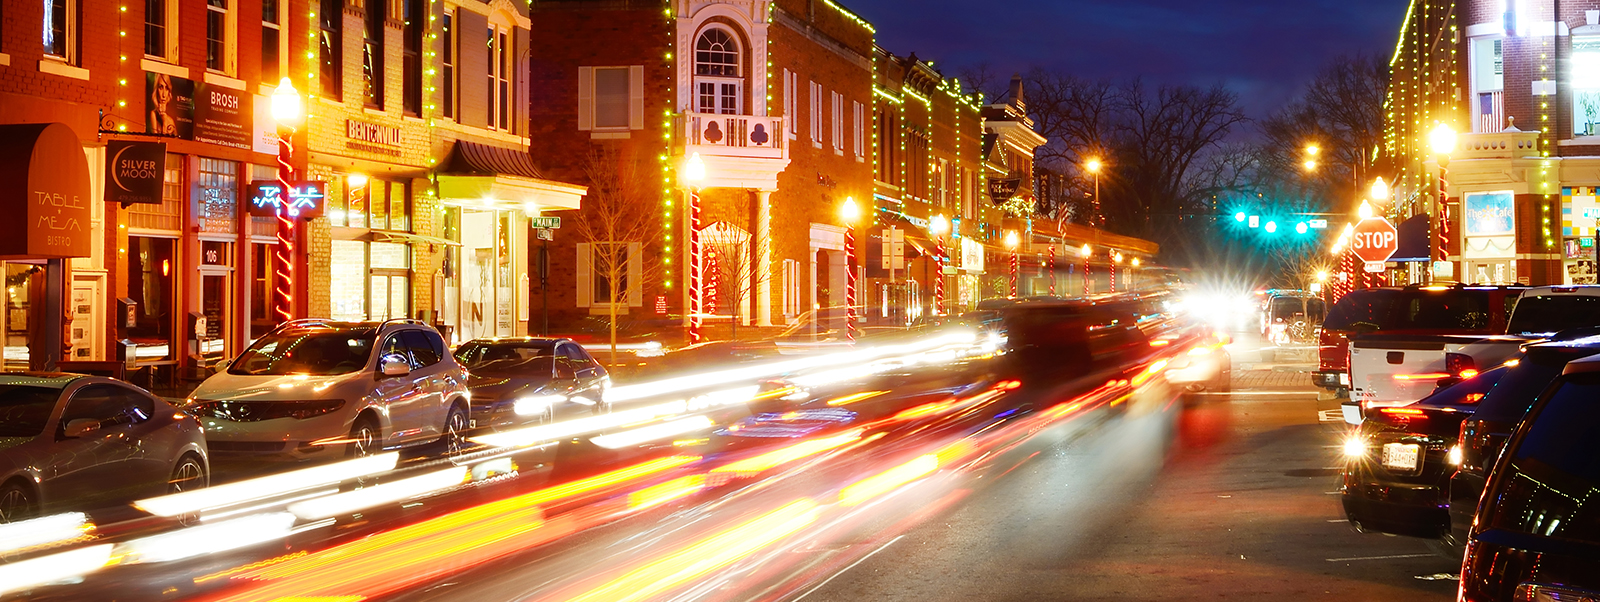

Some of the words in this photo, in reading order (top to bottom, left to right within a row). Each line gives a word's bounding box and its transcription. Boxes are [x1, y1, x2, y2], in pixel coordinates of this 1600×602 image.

[211, 91, 239, 109] BROSH
[121, 159, 156, 170] SILVER
[120, 169, 156, 179] MOON
[1040, 174, 1048, 208] MASSEY
[34, 190, 85, 210] TABLE
[37, 215, 82, 232] MESA
[537, 218, 552, 227] MAIN
[47, 235, 71, 247] BISTRO
[1353, 231, 1394, 249] STOP
[206, 250, 217, 263] 106
